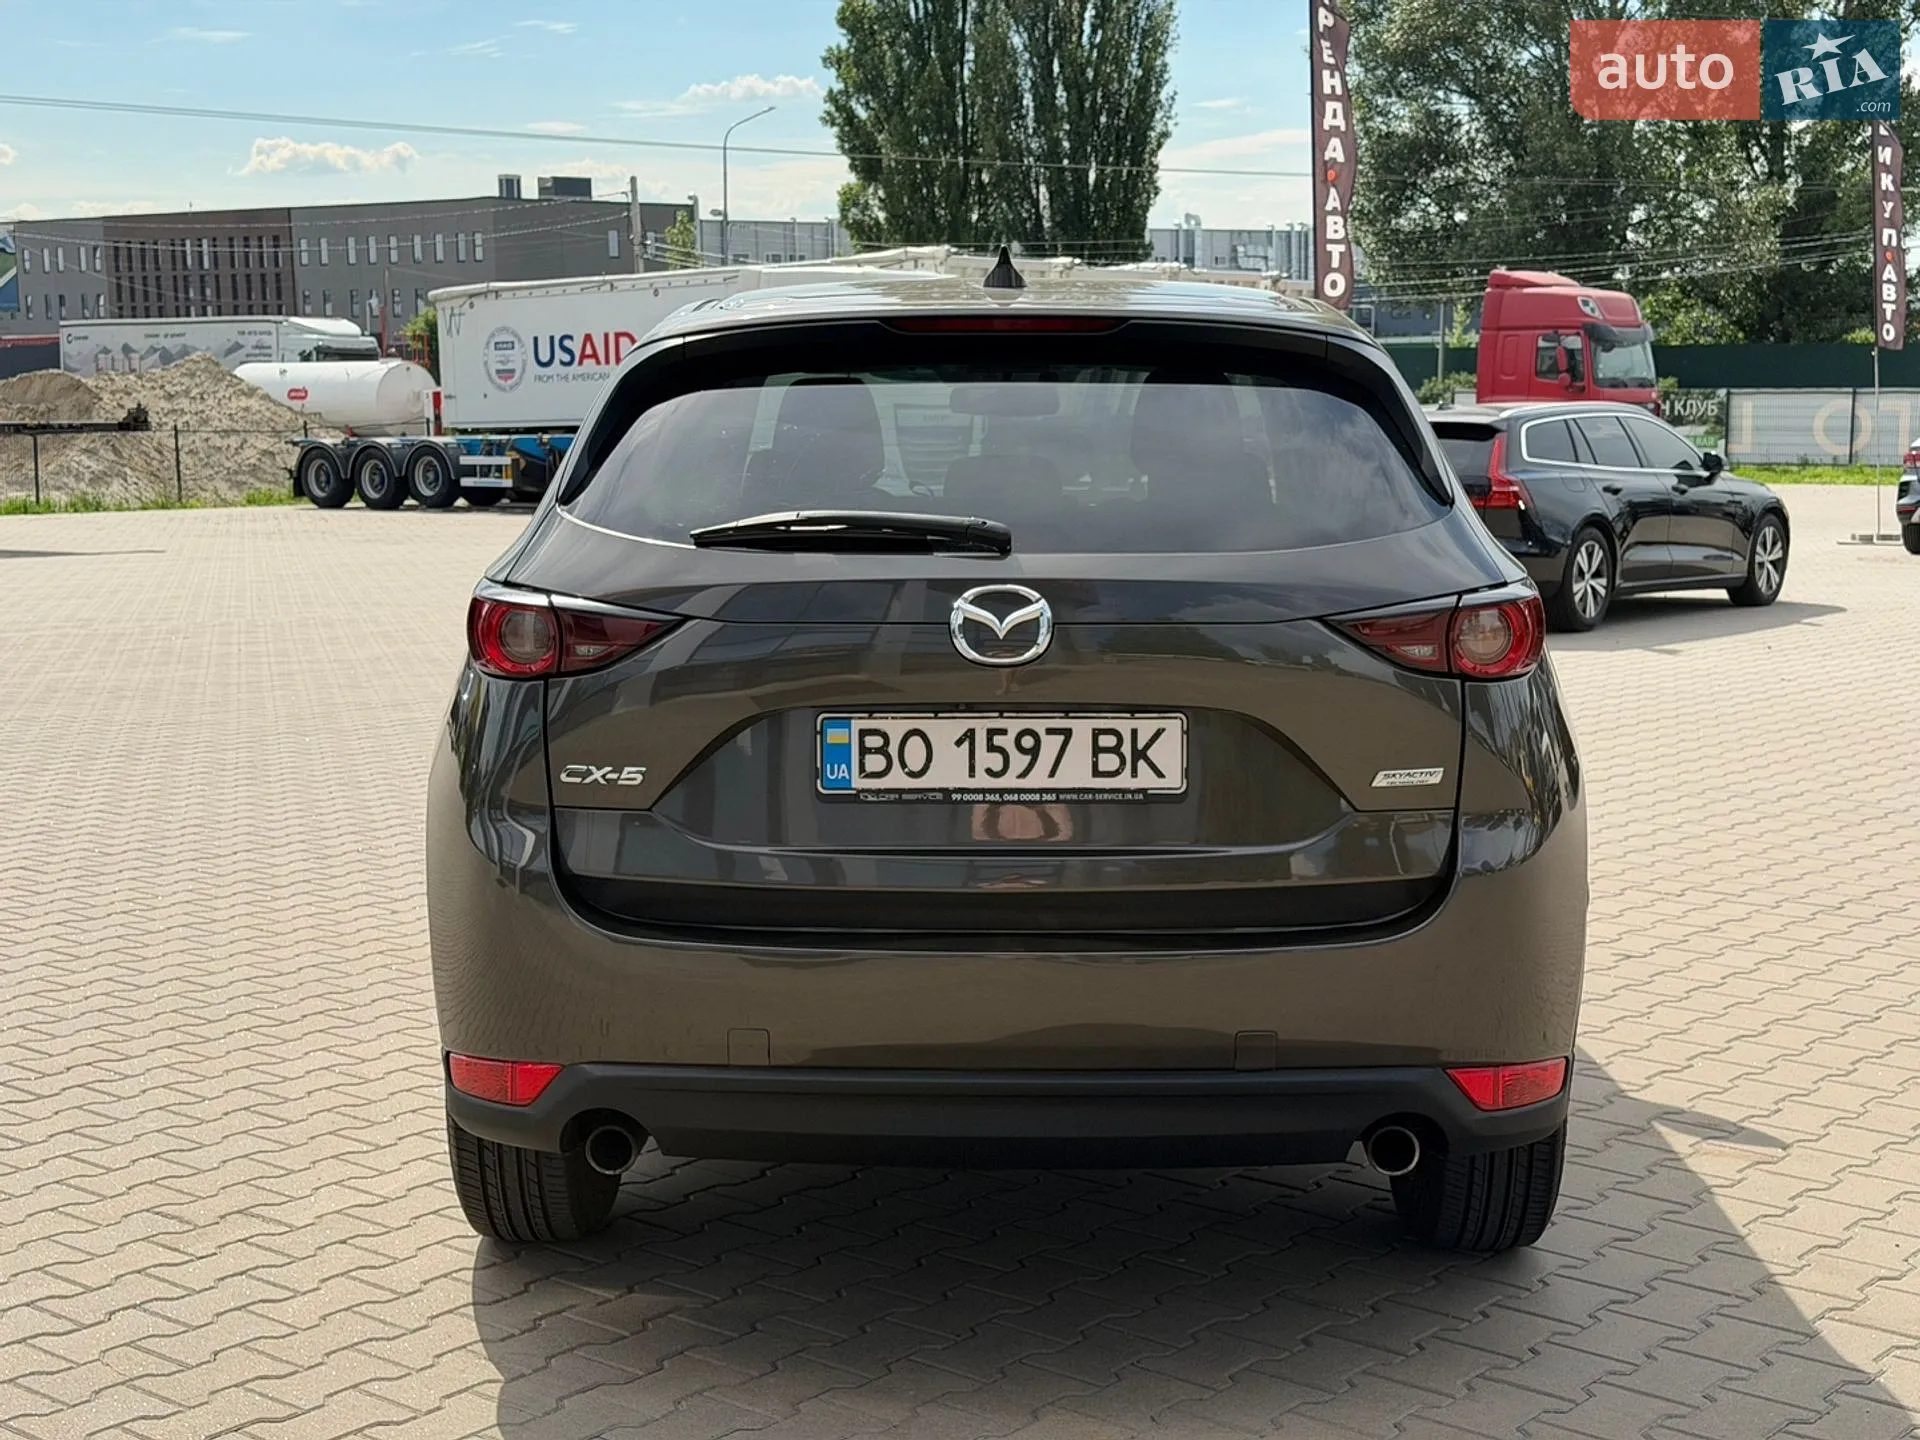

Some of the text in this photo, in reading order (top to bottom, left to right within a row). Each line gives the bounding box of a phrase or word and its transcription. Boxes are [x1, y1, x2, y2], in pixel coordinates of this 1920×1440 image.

[1317, 0, 1347, 298] РЕНДА АВТО
[1881, 263, 1898, 342] АВТО
[532, 331, 640, 368] USAID
[1674, 397, 1719, 418] КЛУБ
[858, 727, 1167, 780] BO 1597 BK
[559, 764, 647, 785] CX-5
[826, 763, 850, 780] UA
[1383, 770, 1437, 780] SKYACTIV
